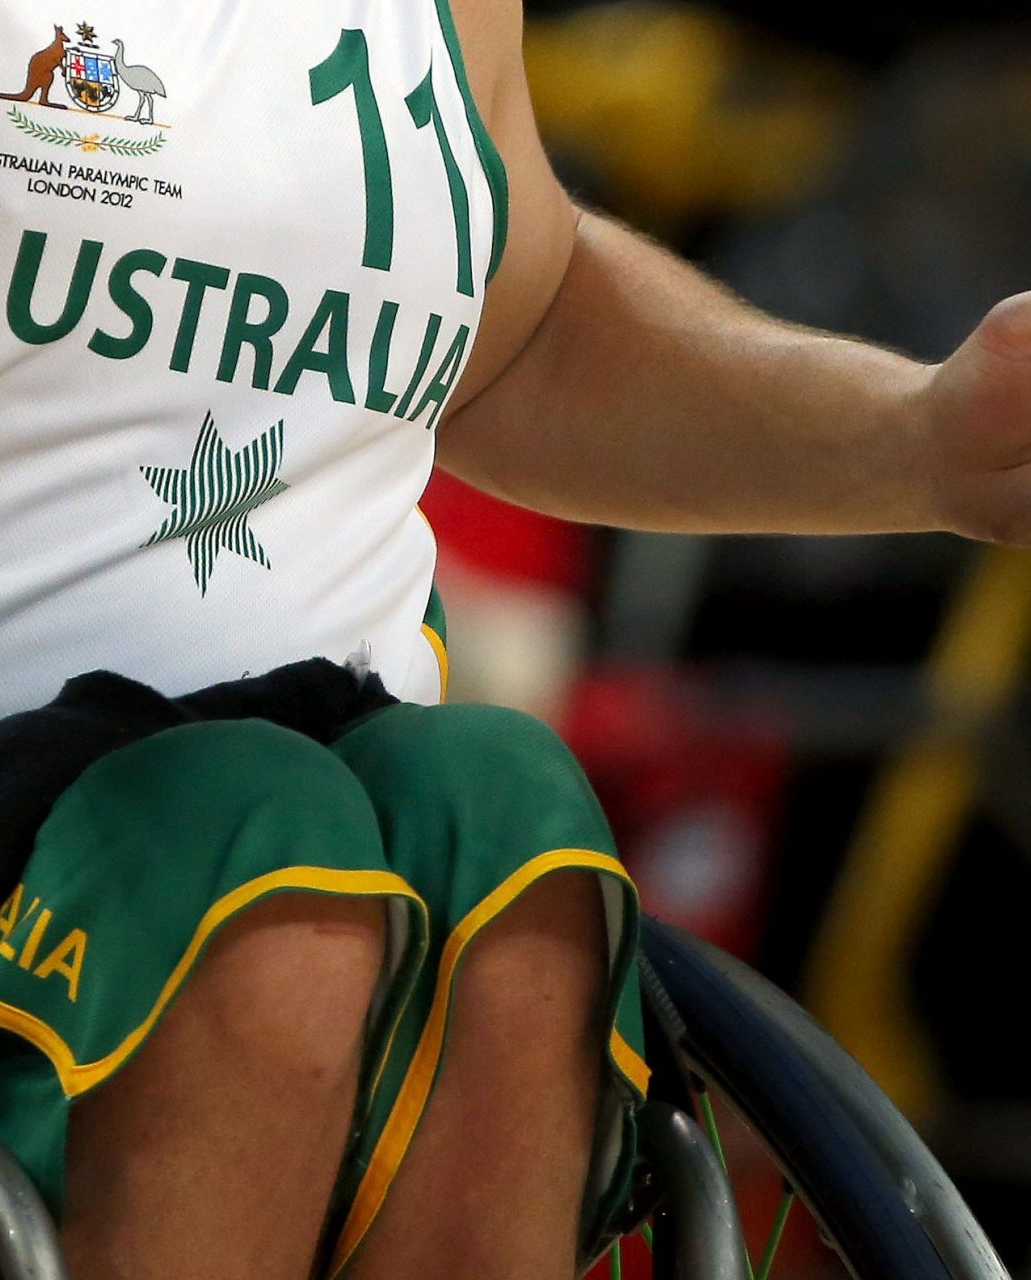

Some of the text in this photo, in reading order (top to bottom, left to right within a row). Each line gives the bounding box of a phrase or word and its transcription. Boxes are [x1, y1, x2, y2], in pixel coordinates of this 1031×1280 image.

[308, 27, 475, 298] 11
[27, 177, 134, 209] LONDON 2012
[69, 164, 149, 192] PARALYMPIC
[153, 178, 183, 200] TEAM
